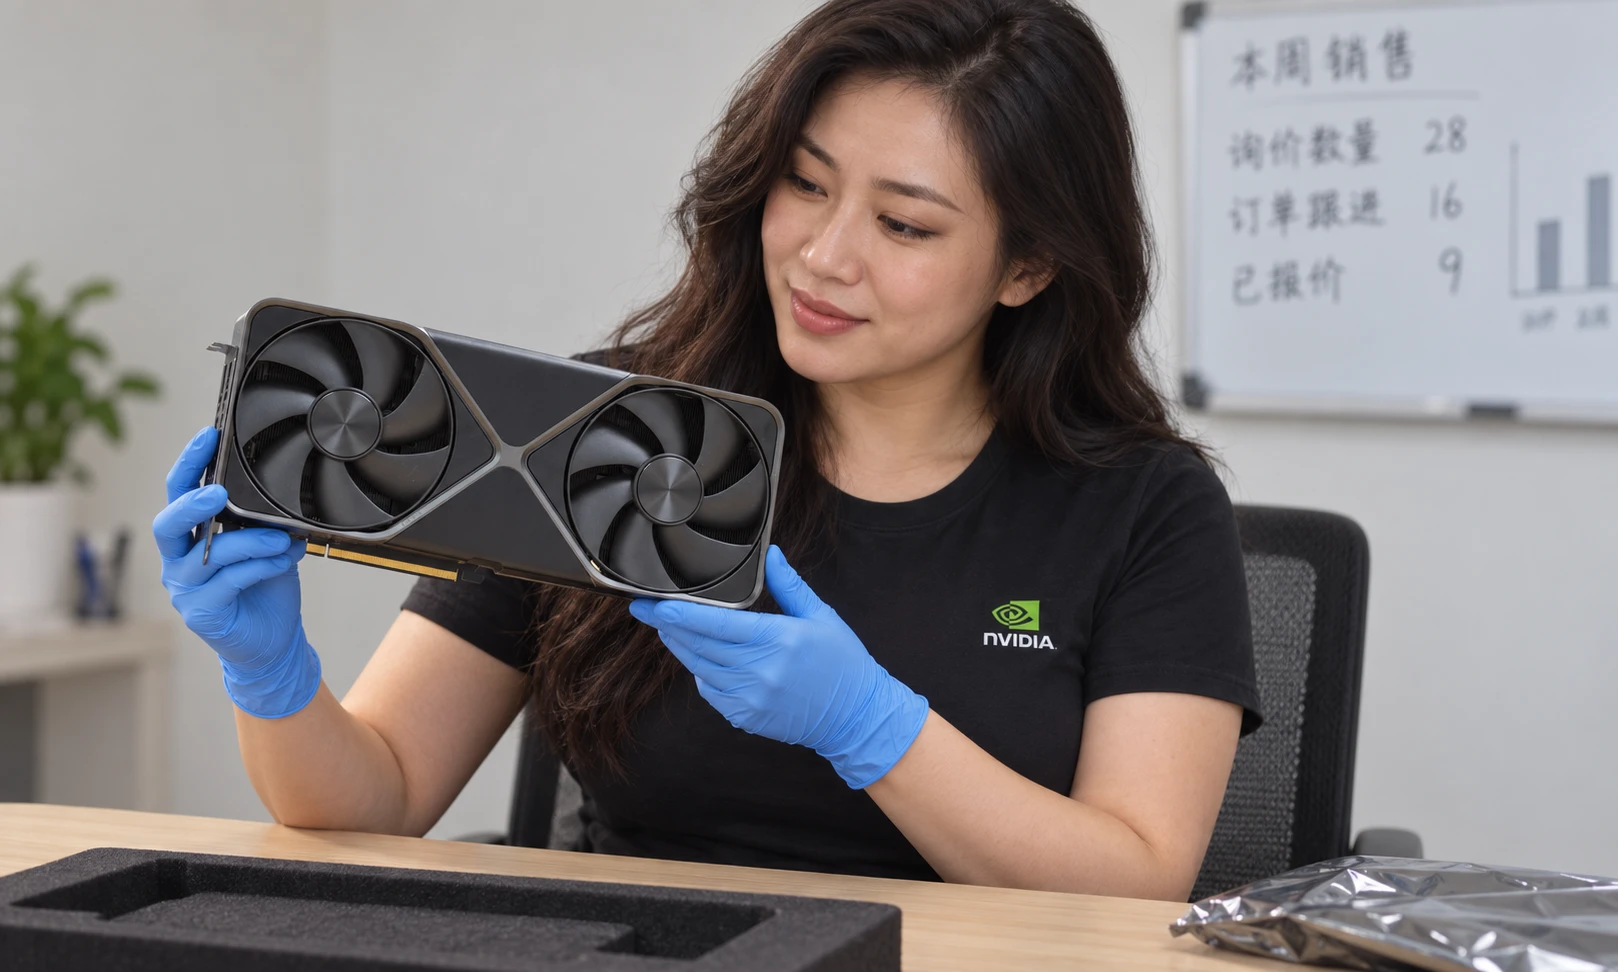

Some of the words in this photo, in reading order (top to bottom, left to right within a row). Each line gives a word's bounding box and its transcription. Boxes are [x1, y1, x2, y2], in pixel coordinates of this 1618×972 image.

[1232, 28, 1413, 88] 本周销售
[1230, 118, 1378, 170] 询价数量
[1424, 116, 1467, 155] 28
[1230, 190, 1382, 235] 订单跟进
[1430, 182, 1463, 220] 16
[1233, 258, 1345, 305] 已报价
[1438, 246, 1463, 295] 9
